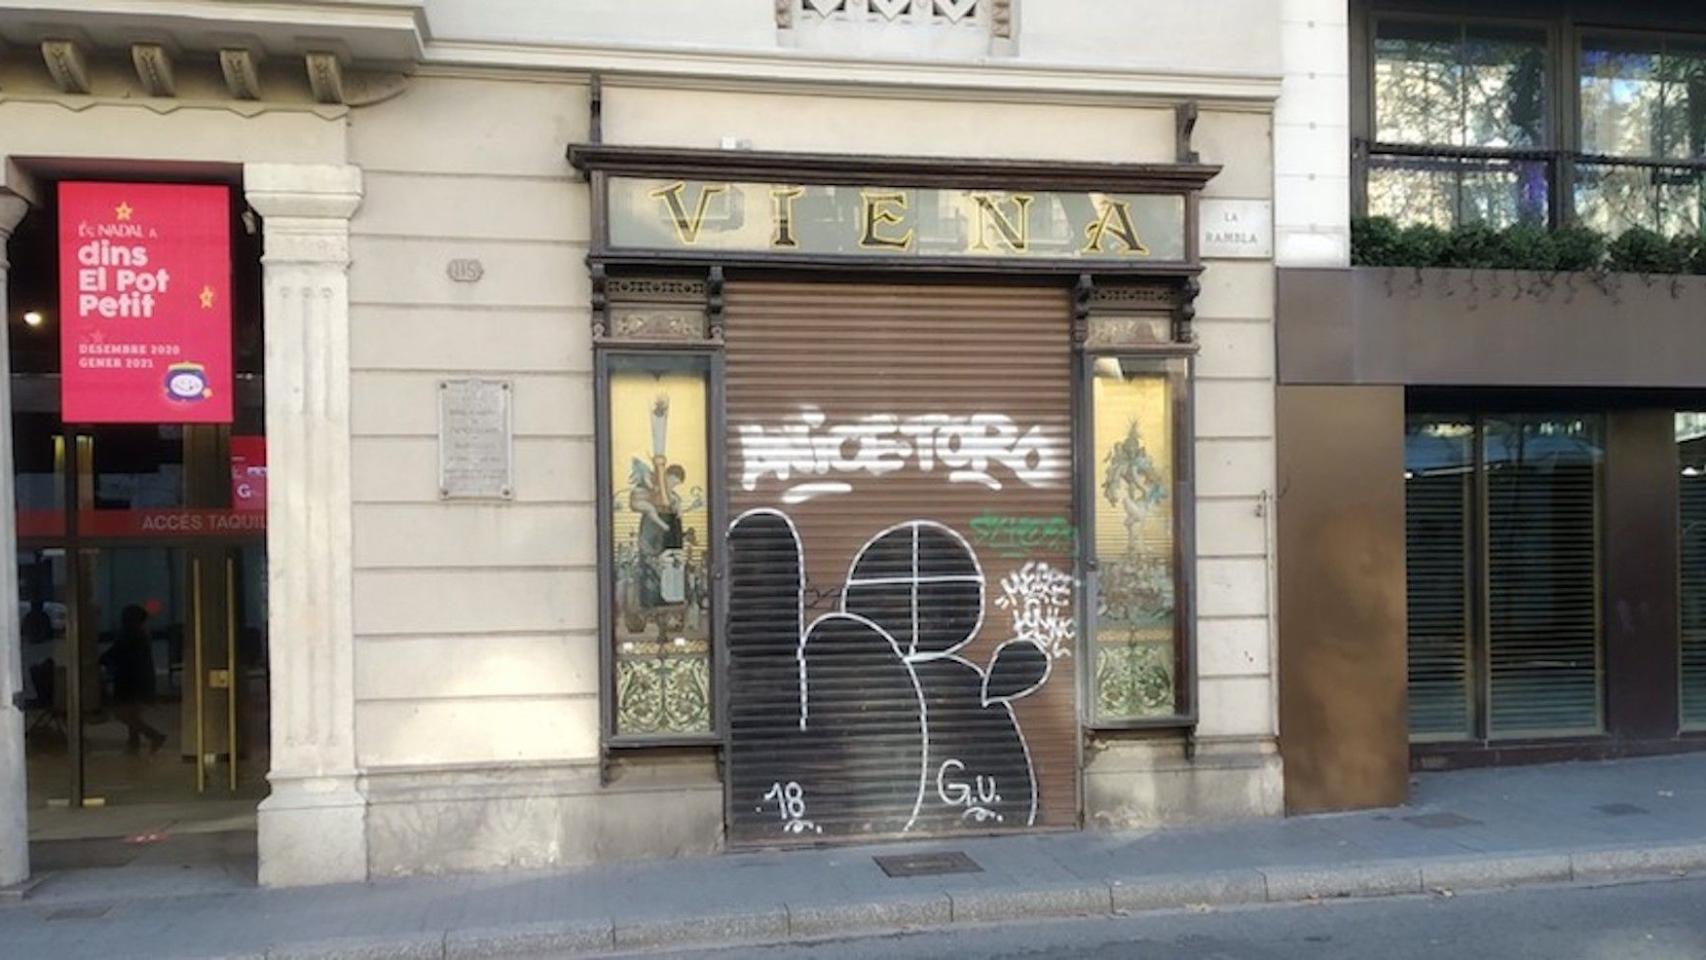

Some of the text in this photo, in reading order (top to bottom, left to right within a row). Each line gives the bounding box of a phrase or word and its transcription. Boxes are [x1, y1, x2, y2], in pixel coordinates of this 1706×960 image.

[650, 184, 1149, 256] VIENA
[1224, 212, 1238, 222] LA
[98, 223, 143, 238] NADAL
[1205, 231, 1257, 244] RAMBLA
[78, 239, 148, 267] dins
[79, 267, 170, 293] El Pot
[79, 291, 155, 318] Petit
[79, 344, 181, 355] DESEMBRE 2020
[79, 358, 154, 368] GENER 2021
